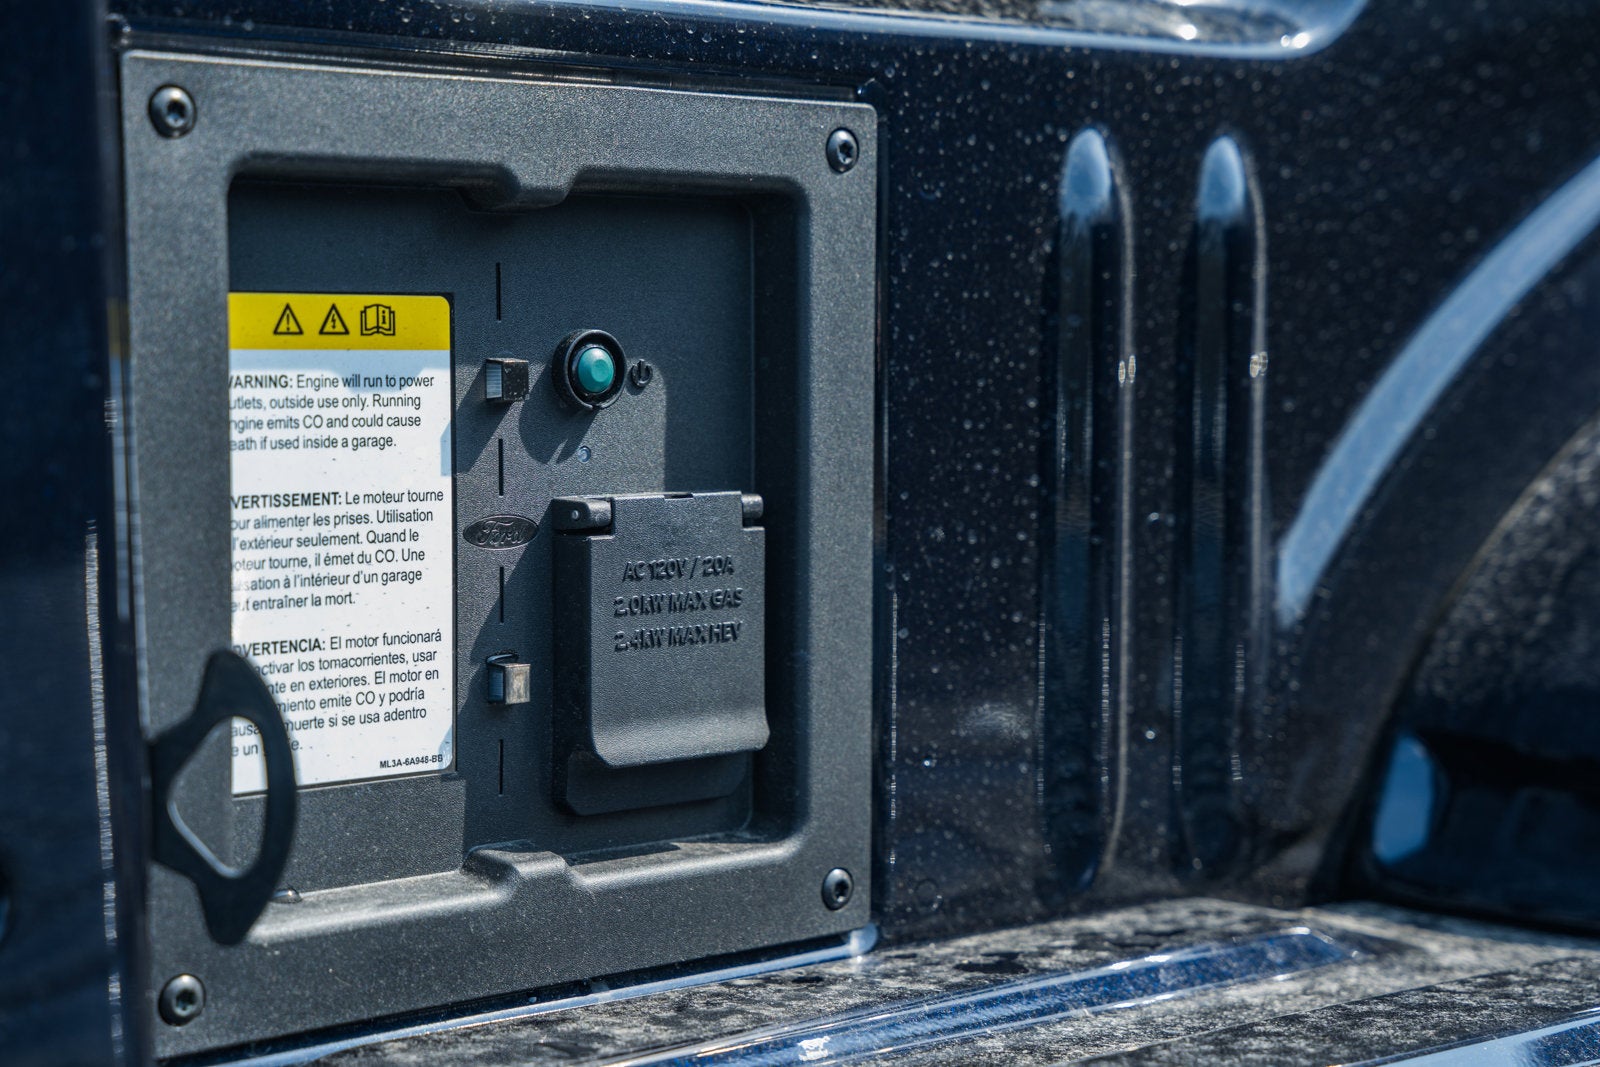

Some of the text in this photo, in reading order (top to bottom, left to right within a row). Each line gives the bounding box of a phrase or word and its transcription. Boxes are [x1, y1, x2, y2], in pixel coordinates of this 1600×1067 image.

[297, 375, 339, 390] Engine
[342, 374, 360, 387] will
[364, 377, 383, 387] run
[386, 376, 396, 387] to
[399, 376, 434, 391] power
[230, 394, 421, 410] utlets, outside use only. Running
[231, 414, 421, 433] ngine emits CO and could cause
[231, 435, 396, 450] eath if used inside a garage.
[231, 490, 443, 509] VERTISSEMENT: Le moteur tourne
[231, 510, 433, 530] our alimenter les prises. Utilisation
[297, 533, 362, 547] seulement.
[367, 530, 406, 545] Quand
[410, 530, 419, 541] le
[477, 520, 526, 546] Ford
[234, 549, 425, 571] oteur tourne, il émet du CO. Une
[622, 555, 735, 581] AC 120V / 20A
[284, 576, 290, 588] à
[294, 574, 349, 587] l'intérieur
[353, 572, 378, 584] d'un
[382, 570, 422, 585] garage
[253, 596, 307, 610] entraîner
[311, 594, 321, 606] la
[325, 592, 355, 606] mort.
[668, 590, 708, 614] MAX
[709, 588, 743, 610] GAS
[233, 629, 441, 658] DVERTENCIA: El motor funcionará
[668, 624, 708, 647] MAX
[708, 621, 743, 644] HEV
[298, 658, 314, 671] los
[319, 654, 408, 669] tomacorrientes,
[413, 650, 437, 662] usar
[291, 681, 305, 692] en
[309, 675, 370, 690] exteriores.
[375, 671, 385, 684] El
[390, 670, 422, 682] motor
[426, 668, 439, 680] en
[320, 693, 351, 708] emite
[356, 691, 375, 705] CO
[379, 693, 385, 707] y
[389, 687, 424, 703] podría
[329, 713, 337, 727] si
[342, 714, 355, 725] se
[359, 712, 380, 724] usa
[384, 707, 426, 722] adentro
[232, 743, 258, 756] e un
[380, 754, 443, 768] ML3A-6A948-BB
